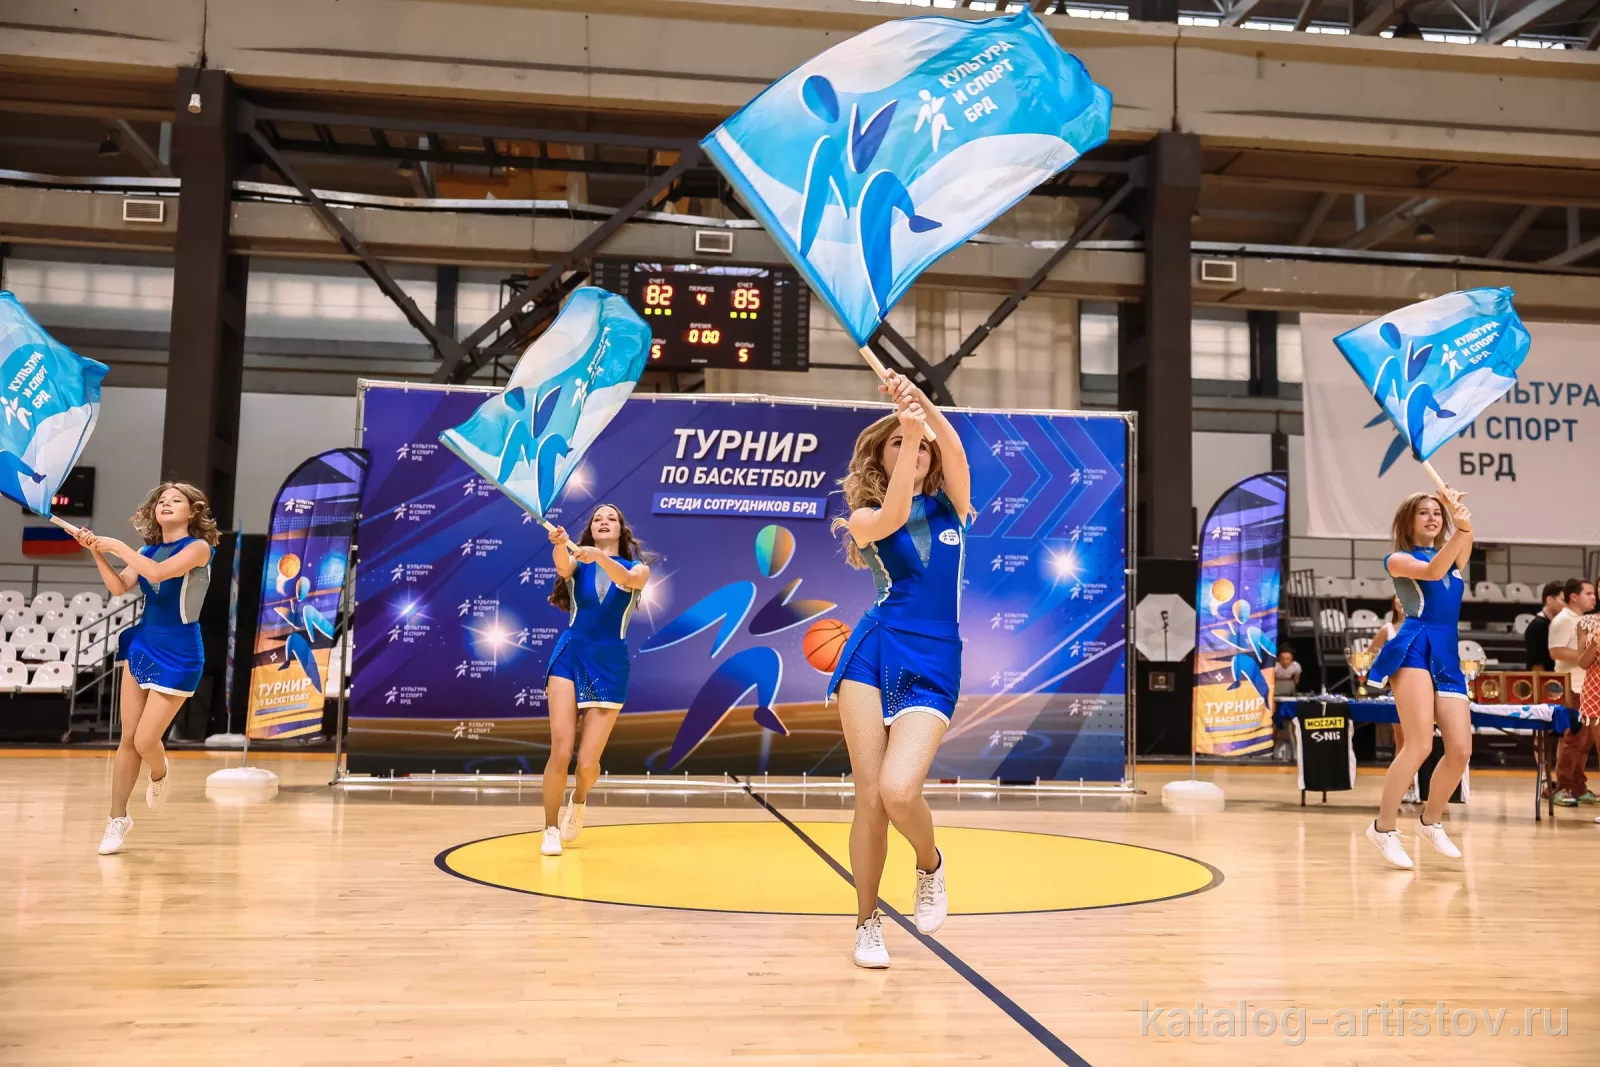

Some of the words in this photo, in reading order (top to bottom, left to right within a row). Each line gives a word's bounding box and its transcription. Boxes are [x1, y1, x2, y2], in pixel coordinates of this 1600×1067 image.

[938, 41, 1014, 88] КУЛЬТУРА
[952, 89, 968, 105] И
[965, 59, 1014, 95] СПОРТ
[964, 96, 998, 122] БРД
[646, 285, 673, 305] 82
[696, 294, 706, 305] 4
[734, 289, 760, 309] 85
[1454, 321, 1500, 347] КУЛЬТУРА
[1461, 348, 1471, 357] И
[1470, 332, 1500, 352] СПОРТ
[652, 345, 661, 358] 5
[738, 349, 748, 362] 5
[1469, 351, 1492, 364] БРД
[8, 351, 44, 392] КУЛЬТУРА
[22, 388, 32, 398] И
[29, 365, 48, 390] СПОРТ
[32, 390, 51, 409] БРД
[1506, 381, 1600, 407] ЬТУРА
[1486, 416, 1578, 442] СПОРТ
[674, 428, 818, 463] ТУРНИР
[660, 466, 689, 483] ПО
[693, 467, 826, 488] БАСКЕТБОЛУ
[1459, 452, 1516, 481] БРД
[660, 498, 701, 510] СРЕДИ
[704, 498, 790, 512] СОТРУДНИКОВ
[792, 501, 817, 514] БРД
[259, 678, 311, 697] ТУРНИР
[1205, 697, 1265, 715] ТУРНИР
